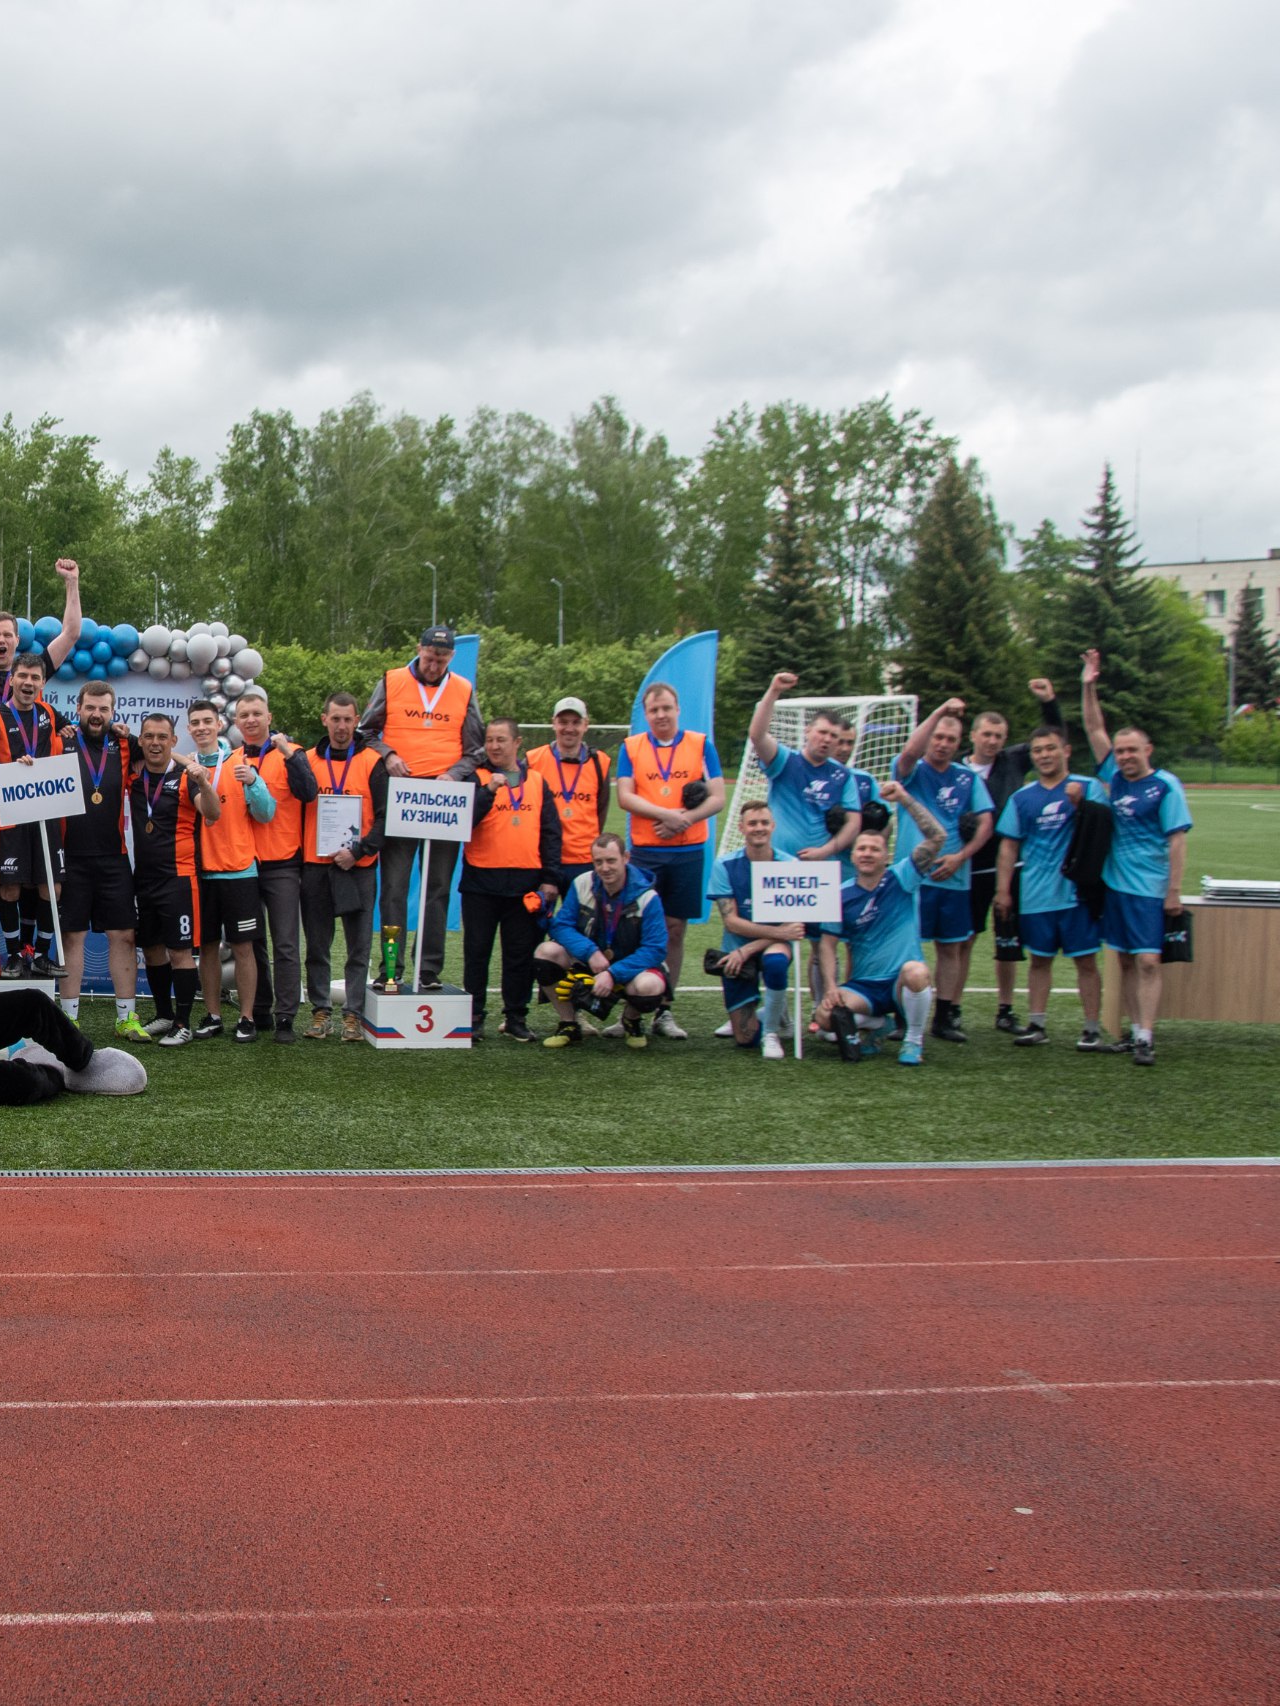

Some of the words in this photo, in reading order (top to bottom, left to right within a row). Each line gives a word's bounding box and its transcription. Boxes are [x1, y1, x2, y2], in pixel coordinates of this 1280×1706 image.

[1, 776, 76, 803] МОСКОКС
[395, 791, 467, 808] УРАЛЬСКАЯ
[401, 808, 459, 827] КУЗНИЦА
[179, 914, 191, 936] 8
[415, 1004, 435, 1034] 3
